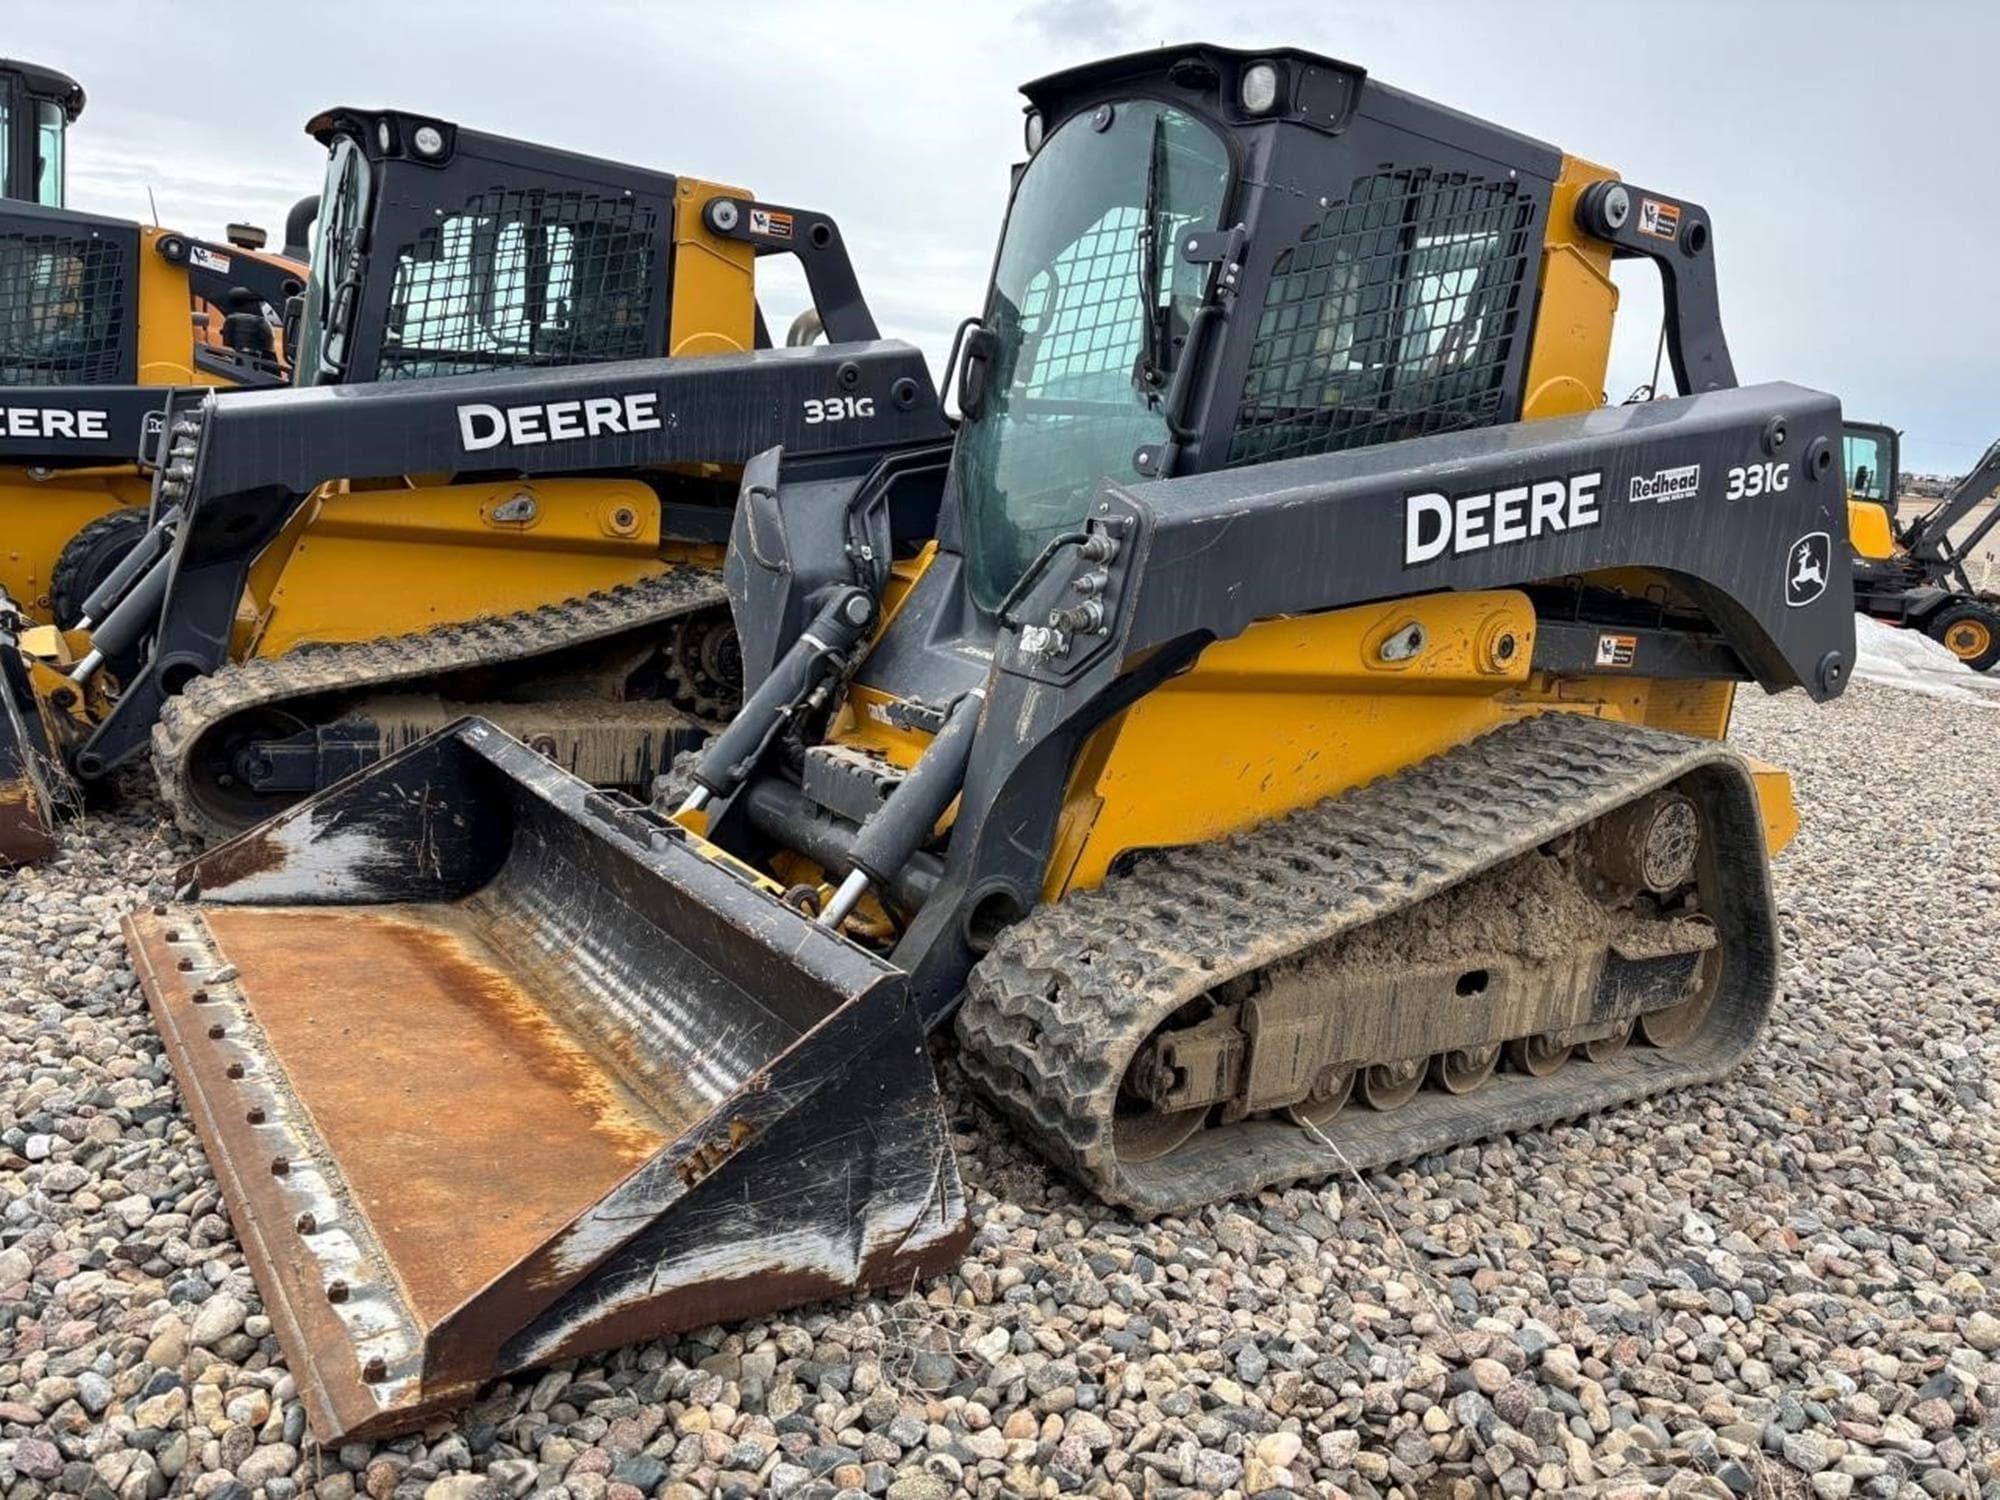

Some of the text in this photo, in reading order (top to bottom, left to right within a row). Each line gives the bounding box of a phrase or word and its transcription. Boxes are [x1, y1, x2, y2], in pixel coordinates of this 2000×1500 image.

[0, 408, 109, 438] ERE
[456, 392, 661, 451] DEERE
[803, 397, 875, 424] 331G
[1632, 467, 1698, 499] Redhead
[1725, 463, 1789, 500] 331G
[1406, 472, 1600, 564] DEERE
